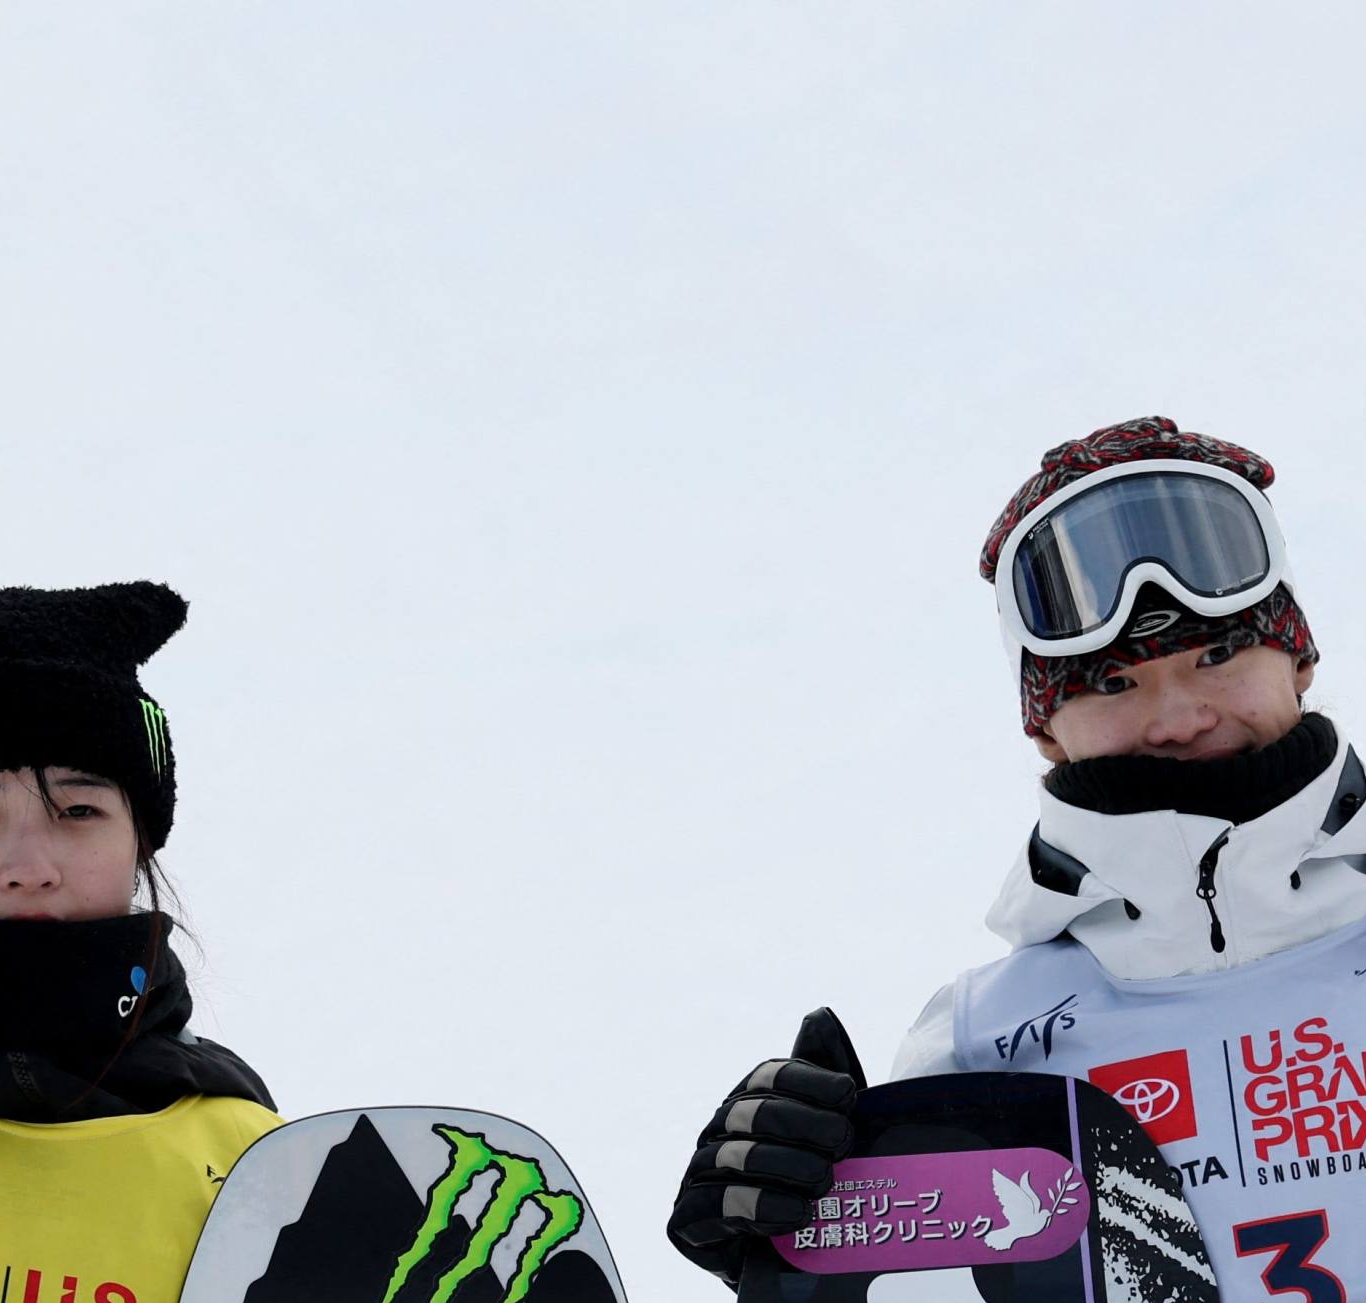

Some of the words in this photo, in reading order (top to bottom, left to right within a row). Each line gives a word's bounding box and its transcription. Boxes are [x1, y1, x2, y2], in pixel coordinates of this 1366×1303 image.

[1240, 1016, 1344, 1076] U.S.
[810, 1189, 942, 1221] 園オリーブ
[794, 1215, 994, 1249] 皮膚科クリニック
